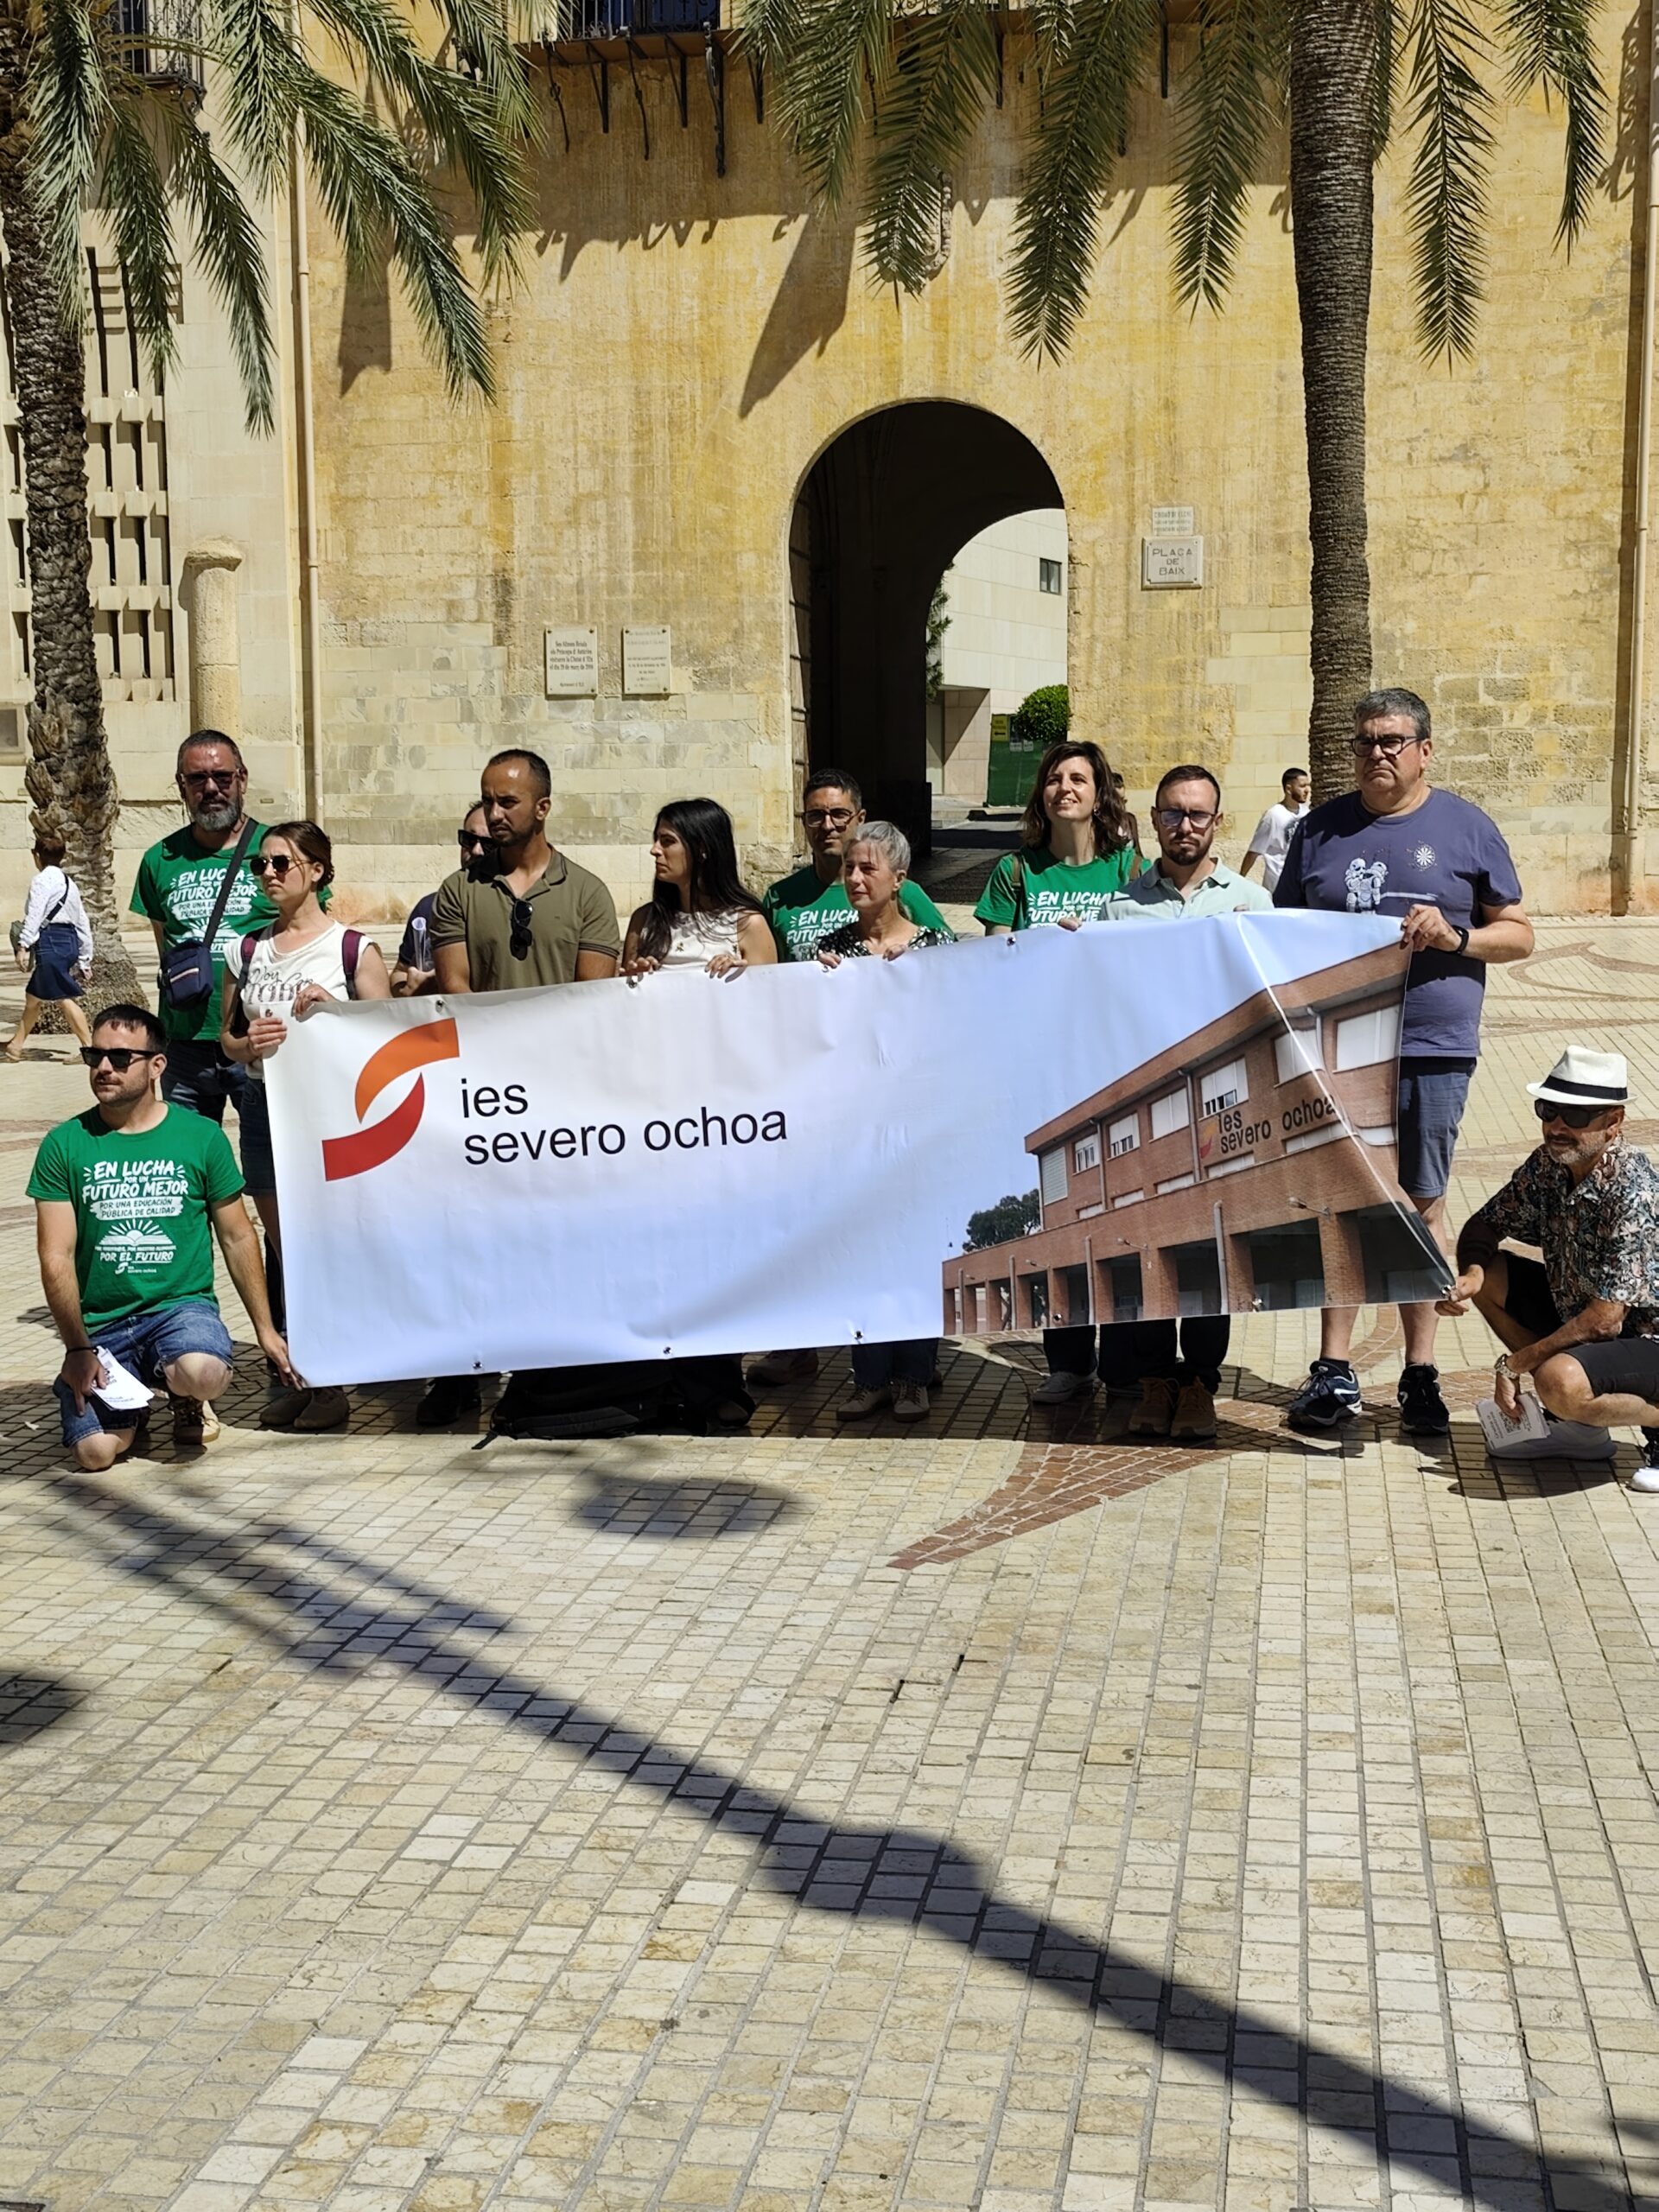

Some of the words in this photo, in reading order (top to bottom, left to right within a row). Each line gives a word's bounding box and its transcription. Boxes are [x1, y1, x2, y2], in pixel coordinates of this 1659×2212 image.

[1159, 567, 1185, 575] BAIX
[177, 870, 197, 887] EN
[199, 868, 245, 881] LUCA
[167, 887, 213, 907] FUTURO
[1037, 891, 1059, 906] EN
[798, 910, 818, 926] EN
[461, 1078, 529, 1119] ies
[1220, 1120, 1271, 1154] severo
[1282, 1094, 1337, 1131] ochoa
[464, 1122, 626, 1166] severo
[644, 1106, 787, 1151] ochoa
[94, 1160, 118, 1179] EN
[122, 1160, 175, 1177] LUCHA
[82, 1183, 140, 1205] FUTURO
[143, 1180, 188, 1197] MEJOR
[99, 1201, 114, 1210] POR
[134, 1197, 173, 1207] EDUCACIÓN
[101, 1209, 133, 1218] PÚBLICA
[146, 1206, 175, 1215] CALIDAD
[100, 1252, 118, 1262] POR
[119, 1252, 132, 1262] EL
[135, 1250, 174, 1262] FUTURO
